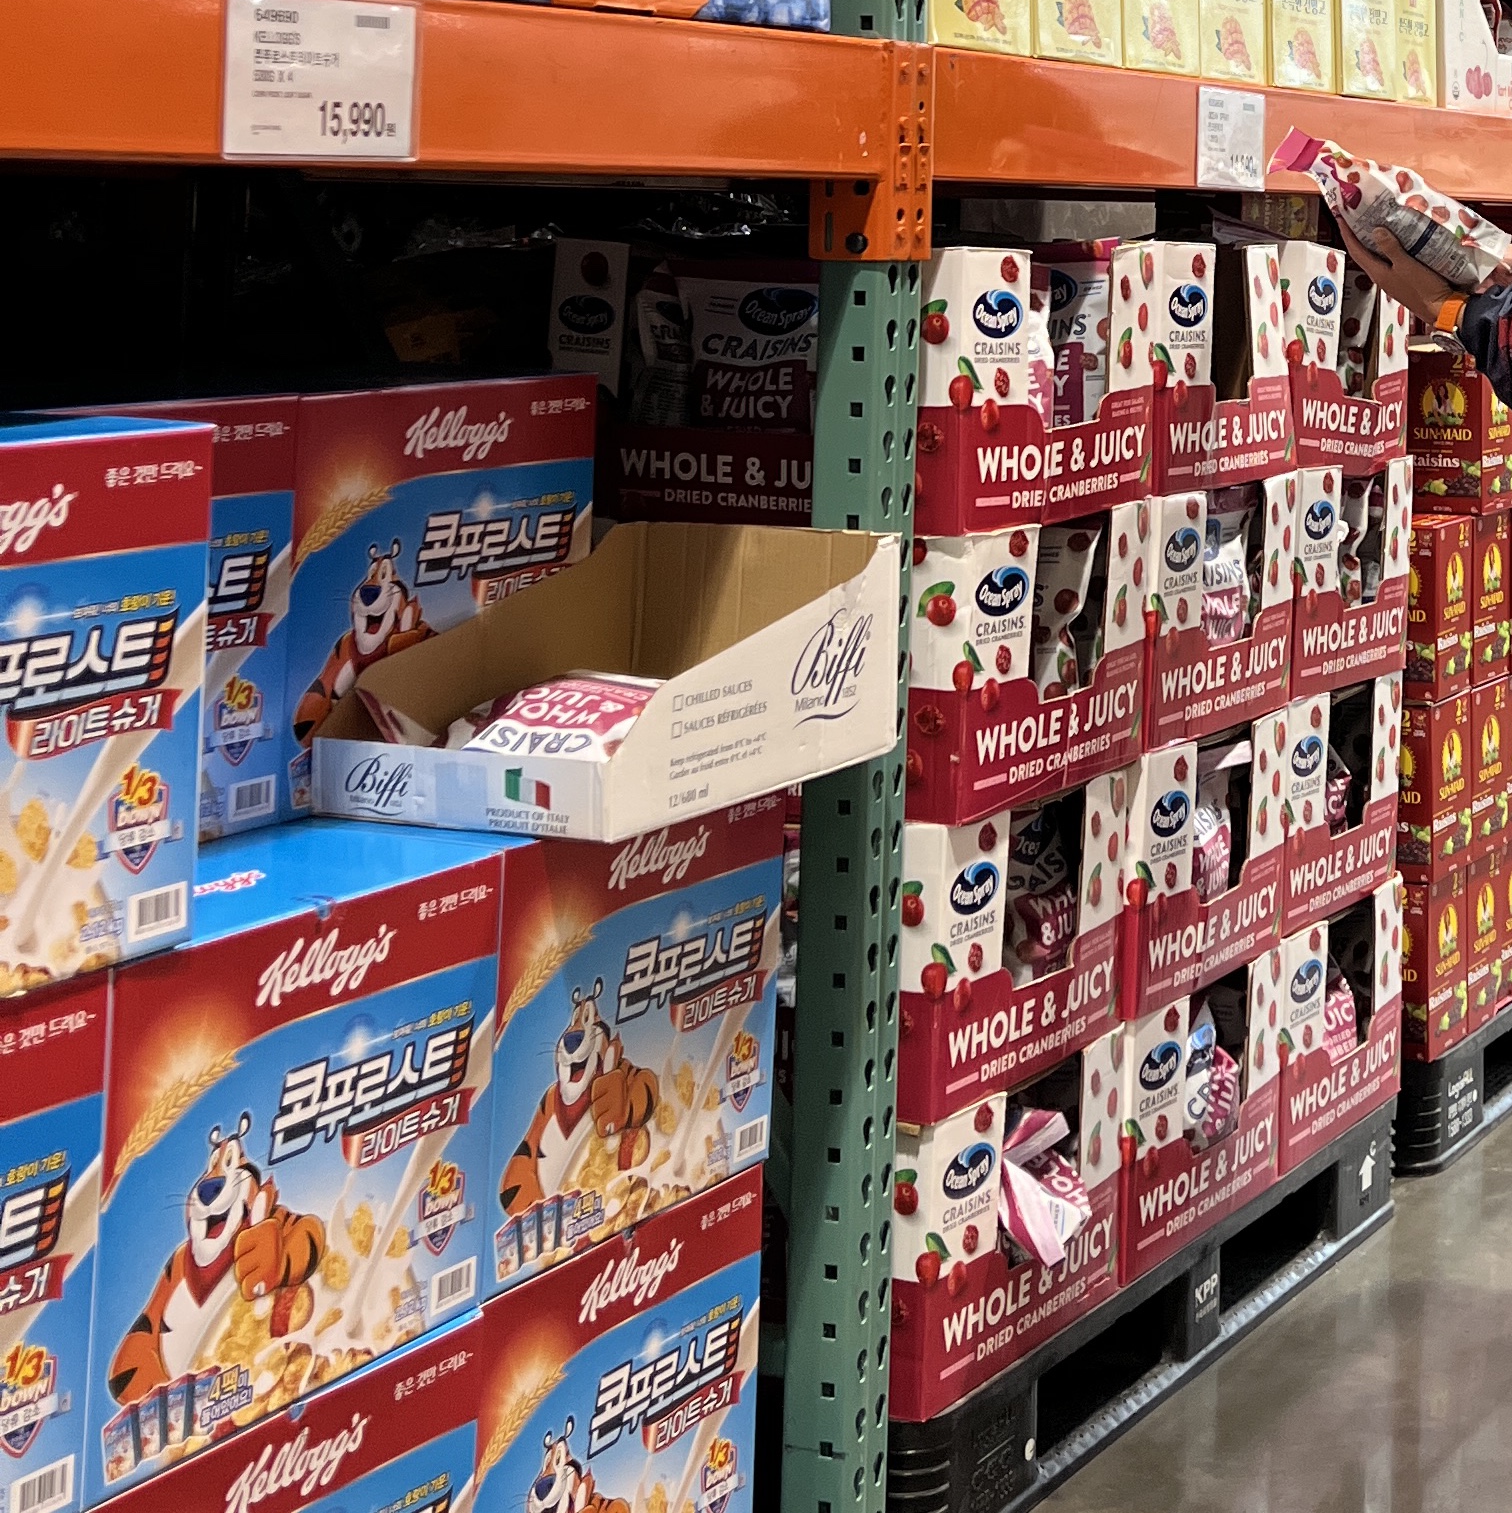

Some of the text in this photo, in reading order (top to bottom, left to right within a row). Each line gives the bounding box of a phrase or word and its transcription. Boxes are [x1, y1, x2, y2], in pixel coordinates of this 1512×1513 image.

[318, 100, 386, 145] 15,990
[975, 304, 1018, 332] Ocean Spray
[702, 332, 818, 361] CRAISINS
[974, 341, 1021, 356] CRAISINS
[404, 406, 514, 461] Kellogg's
[977, 423, 1146, 483] WHOLE & JUICY
[1413, 427, 1473, 441] SUN-MAID
[620, 448, 734, 484] WHOLE
[745, 453, 766, 484] &
[664, 488, 812, 513] DRIED CRANBERRIE
[416, 512, 562, 584] 콘푸로스트
[978, 580, 1023, 608] Ocean Spray
[976, 615, 1026, 637] CRAISINS
[1303, 606, 1405, 658] WHOLE & JUICY
[1161, 635, 1287, 703] WHOLE & JUICY
[1322, 645, 1387, 675] DRIED CRANBERRIES
[685, 680, 753, 707] CHILLED SAUCES
[1184, 681, 1266, 721] DRIED CRANBERRIES
[30, 696, 162, 756] 라이트슈거
[683, 715, 715, 733] SAUCES
[976, 679, 1138, 766] WHOLE & JUICY
[1009, 733, 1111, 784] DRIED CRANBERRIES
[120, 764, 157, 805] 1/3
[344, 752, 413, 812] Biffi
[485, 807, 570, 824] PRODUCT OF ITALY
[489, 820, 532, 833] PRODUIT
[608, 825, 714, 890] Kellogg's
[417, 899, 437, 922] 좋은
[438, 895, 458, 916] 것만
[953, 876, 994, 905] Ocean Spray
[949, 910, 996, 939] CRAISINS
[255, 923, 398, 1008] Kellogg's
[617, 919, 754, 1021] 콘푸로스트
[683, 974, 758, 1031] 라이트슈거
[19, 1023, 46, 1047] 것만
[269, 1032, 459, 1165] 콘푸로스트
[359, 1092, 459, 1168] 라이트슈거
[945, 1155, 990, 1190] Ocean Spray
[942, 1191, 992, 1224] CRAISINS
[578, 1238, 685, 1325] Kellogg's
[1195, 1273, 1219, 1306] KPP
[4, 1350, 45, 1385] 1/3
[588, 1320, 731, 1458] 콘푸로스트
[655, 1377, 733, 1449] 라이트슈거
[226, 1412, 372, 1512] Kellogg's
